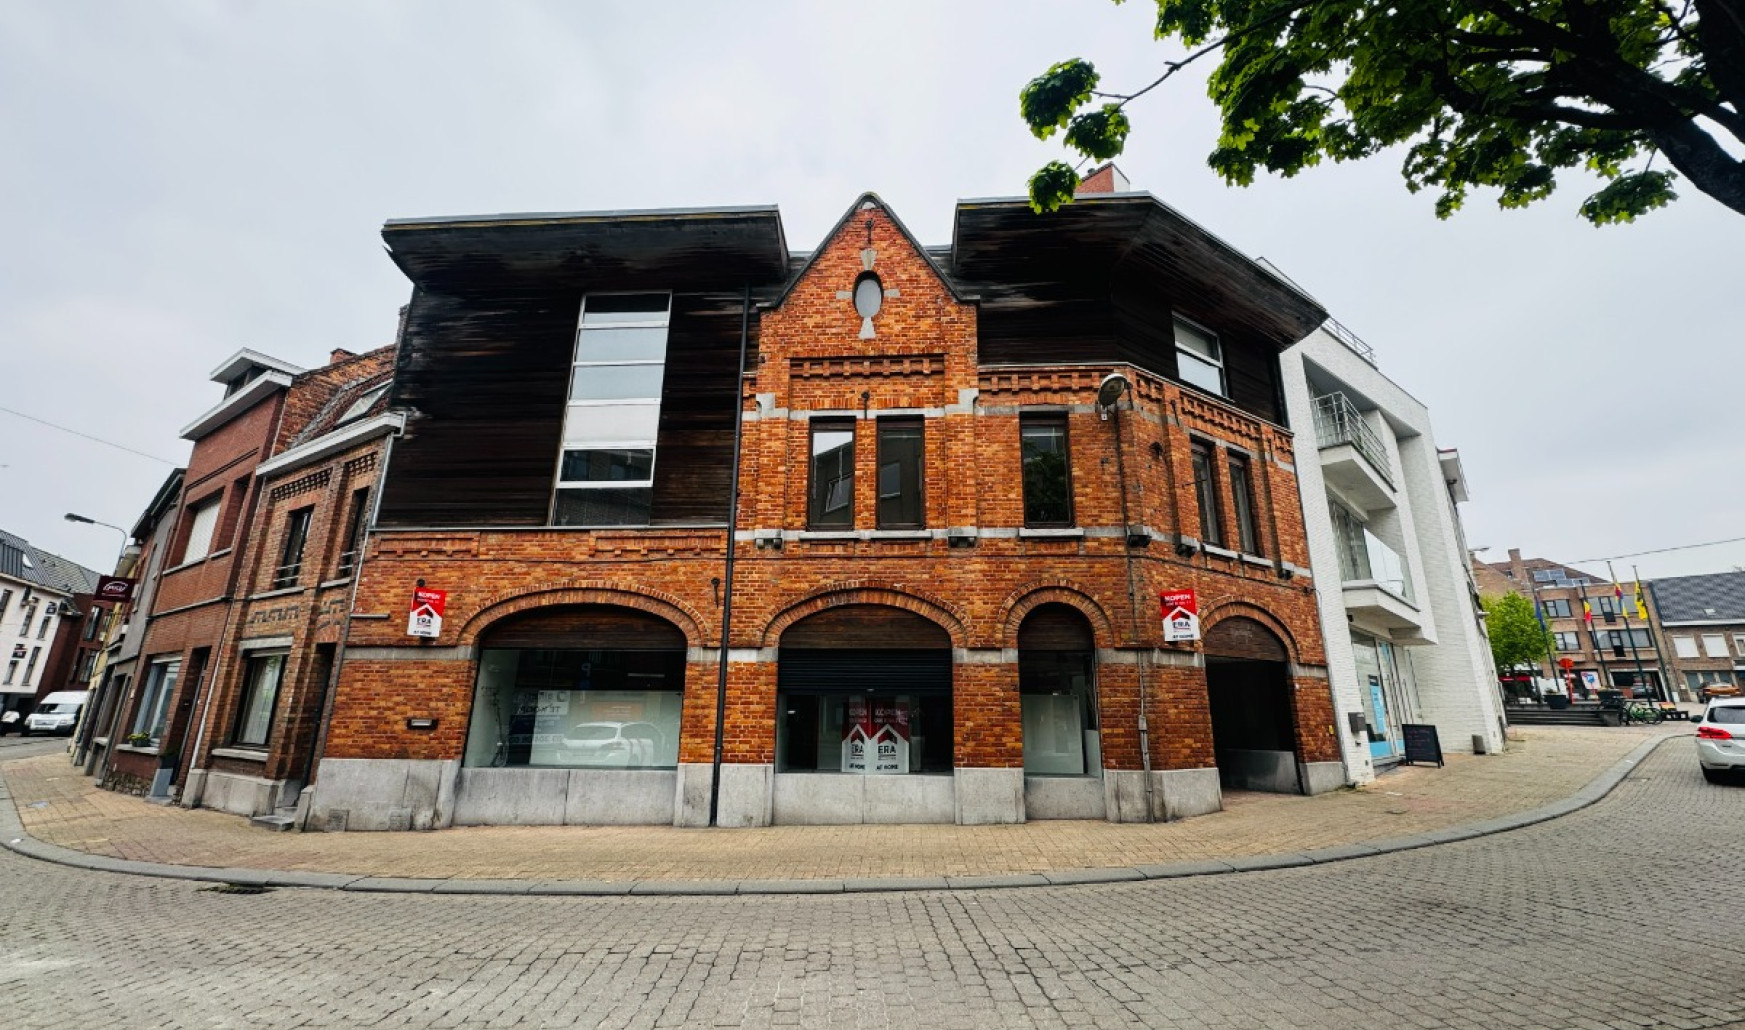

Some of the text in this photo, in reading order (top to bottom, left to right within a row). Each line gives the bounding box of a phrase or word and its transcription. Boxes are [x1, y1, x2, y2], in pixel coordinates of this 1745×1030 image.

[417, 617, 431, 625] ERA
[851, 744, 864, 753] ERA
[877, 745, 896, 754] ERA
